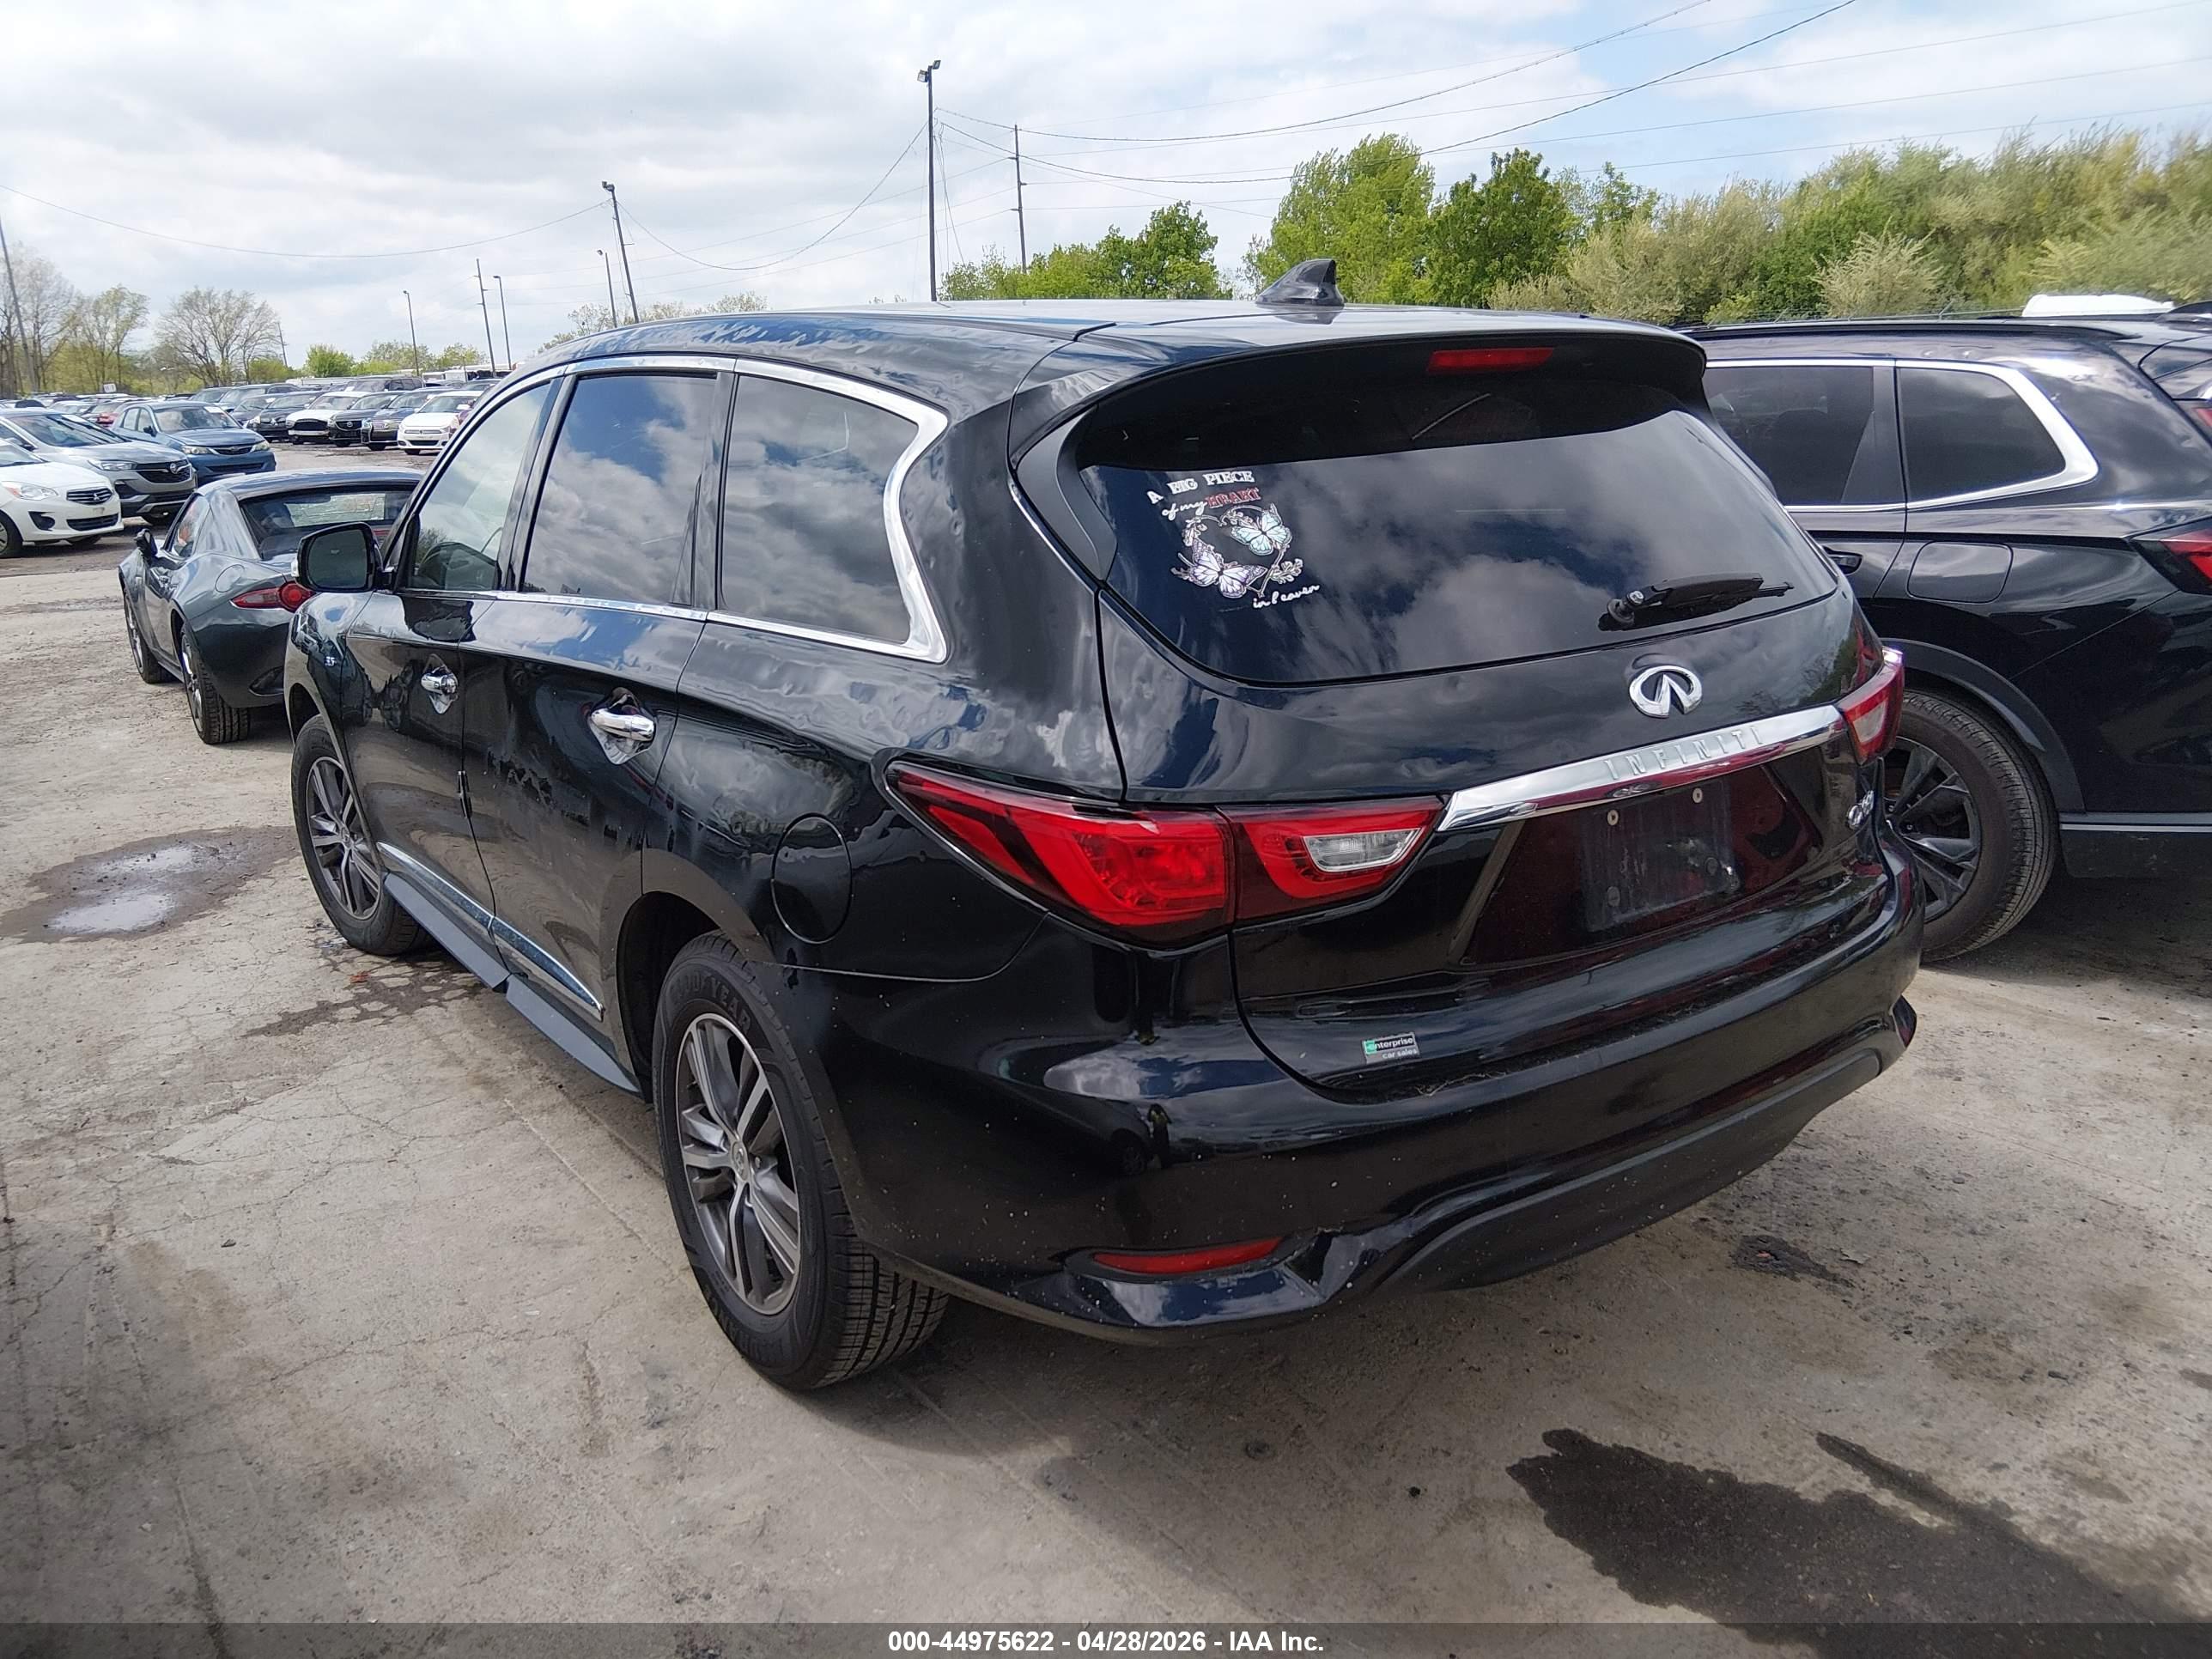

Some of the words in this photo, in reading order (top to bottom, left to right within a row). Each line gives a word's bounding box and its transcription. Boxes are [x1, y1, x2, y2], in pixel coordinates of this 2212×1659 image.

[1147, 490, 1164, 504] A
[1167, 478, 1198, 495] BIG
[1202, 471, 1255, 486] PIECE
[1162, 503, 1179, 521] of
[1180, 501, 1207, 516] my
[1205, 487, 1261, 508] HEART
[1604, 726, 1763, 781] INFINITI
